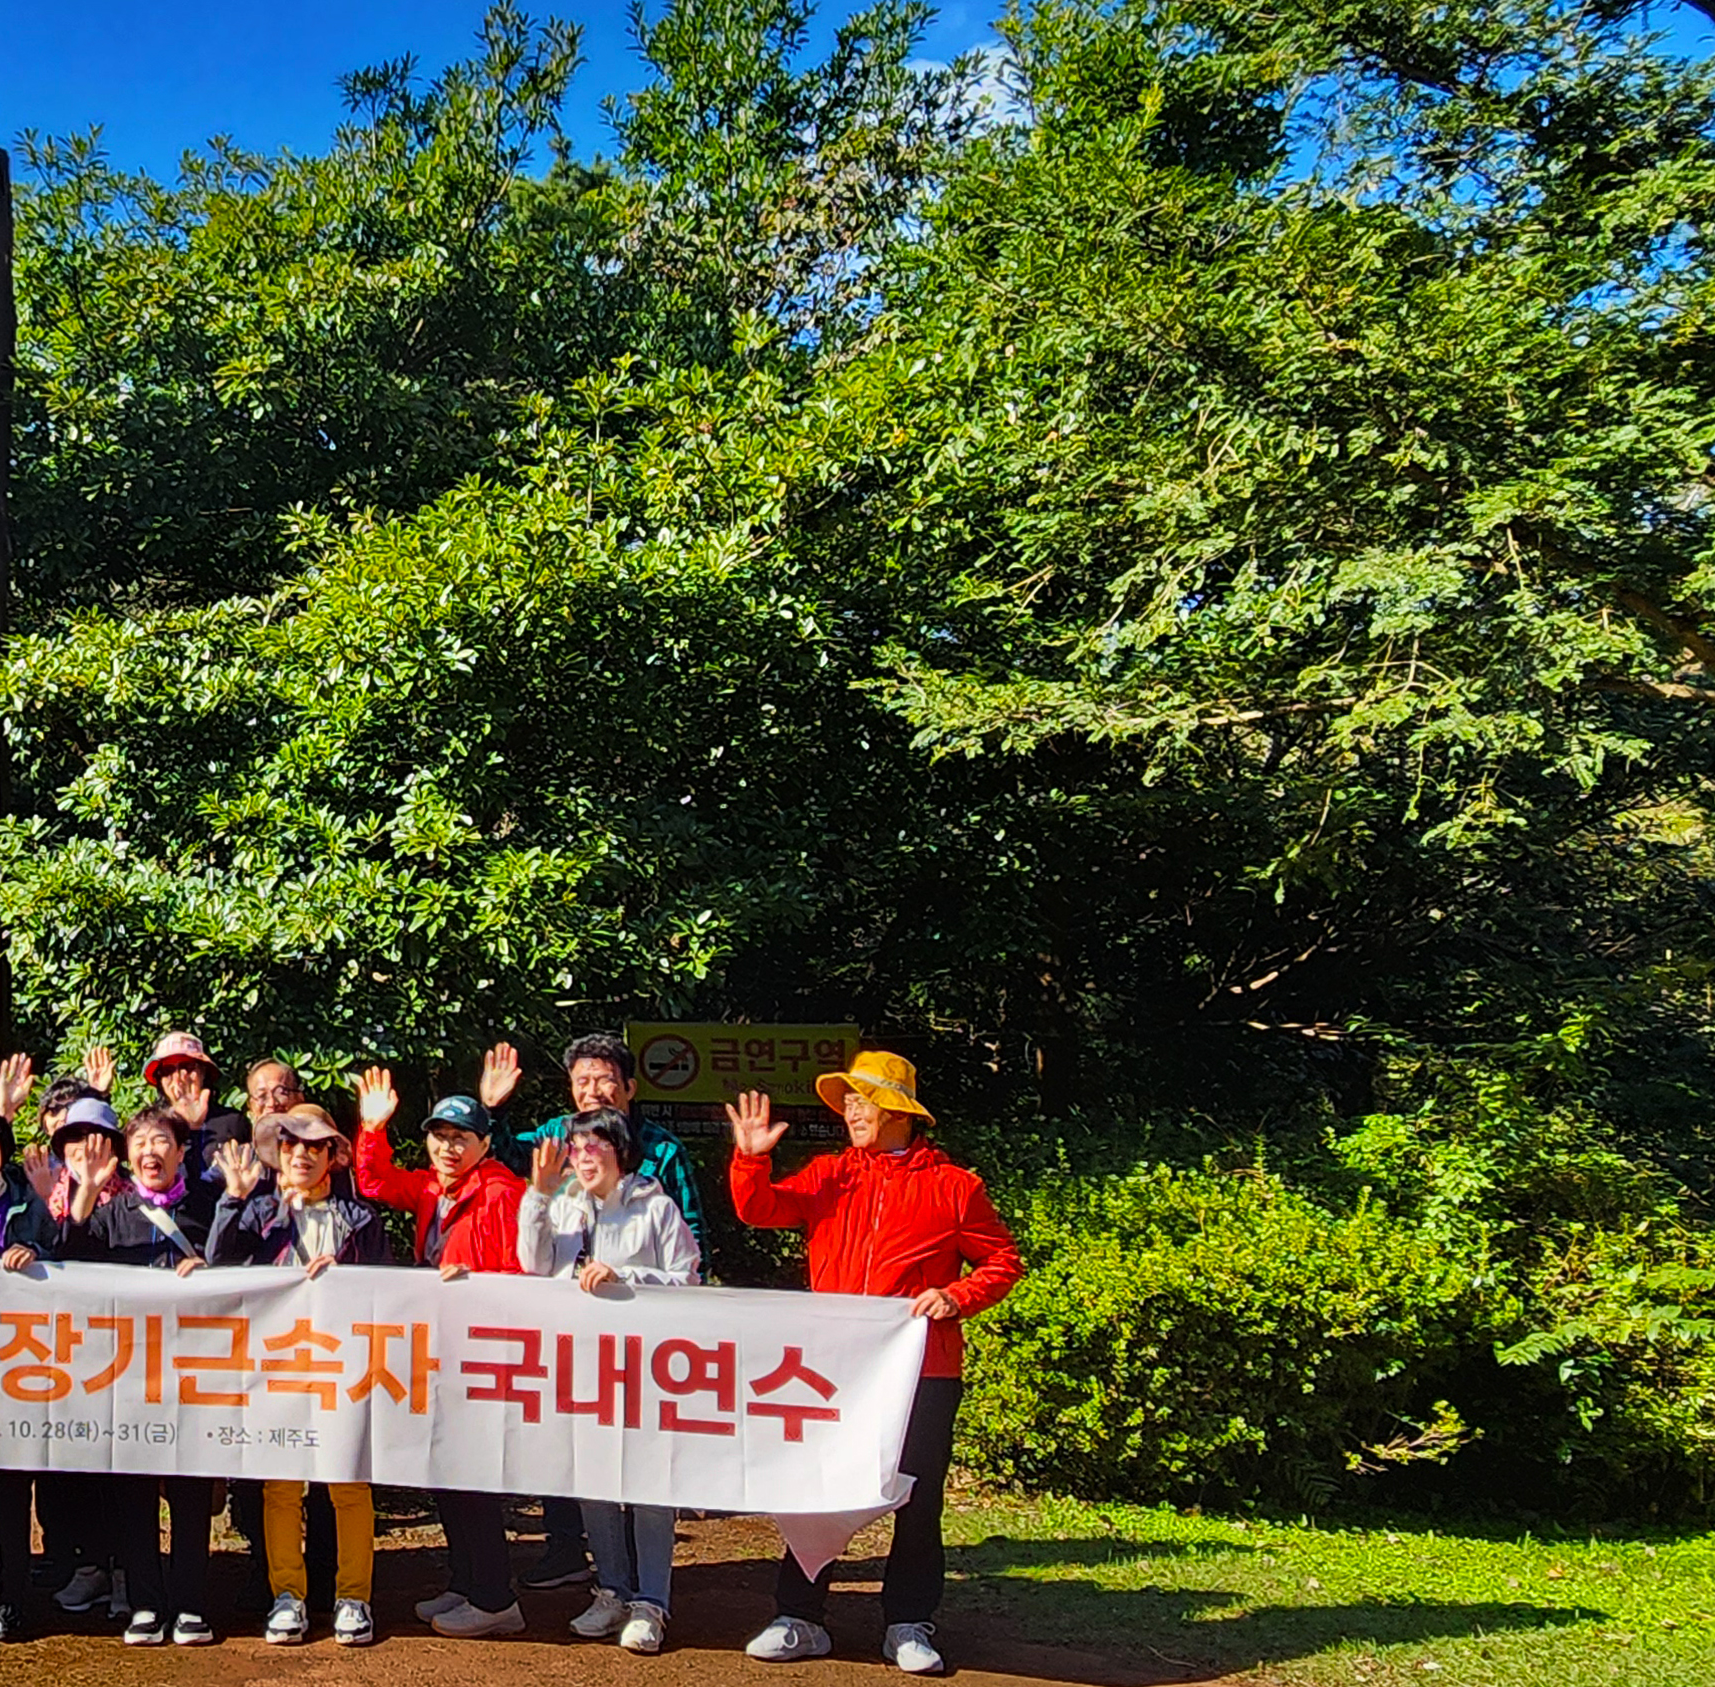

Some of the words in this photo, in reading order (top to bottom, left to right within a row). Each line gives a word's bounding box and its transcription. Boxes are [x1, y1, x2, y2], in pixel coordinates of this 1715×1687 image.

[710, 1037, 846, 1072] 금연구역
[459, 1325, 840, 1443] 국내연수
[8, 1420, 36, 1438] 10.
[218, 1426, 251, 1446] 장소
[269, 1428, 320, 1448] 제주도
